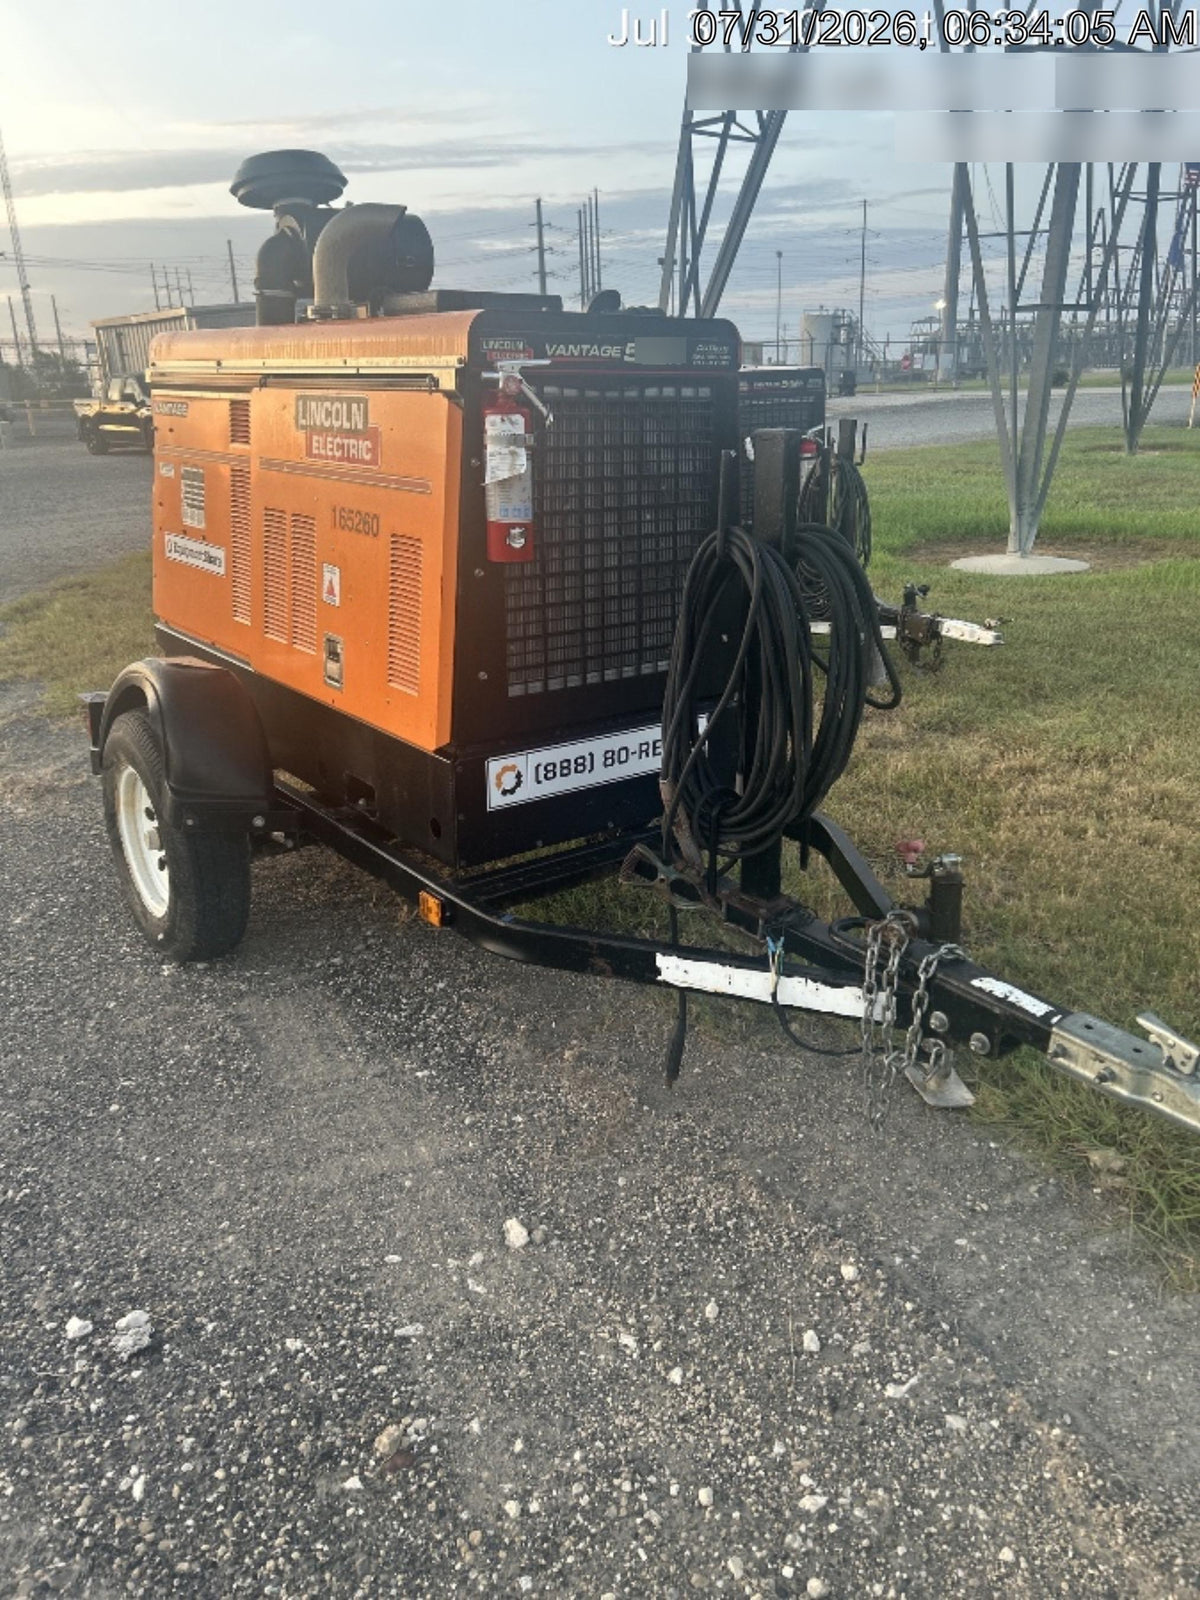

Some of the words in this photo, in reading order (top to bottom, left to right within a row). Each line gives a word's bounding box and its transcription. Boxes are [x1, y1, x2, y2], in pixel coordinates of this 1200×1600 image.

[482, 340, 524, 350] LINCOLN
[545, 343, 622, 358] VANTAGE
[297, 398, 364, 430] LINCOLN
[311, 435, 372, 460] ELECTRIC
[534, 752, 594, 785] (888)
[603, 739, 662, 769] 80-RE
